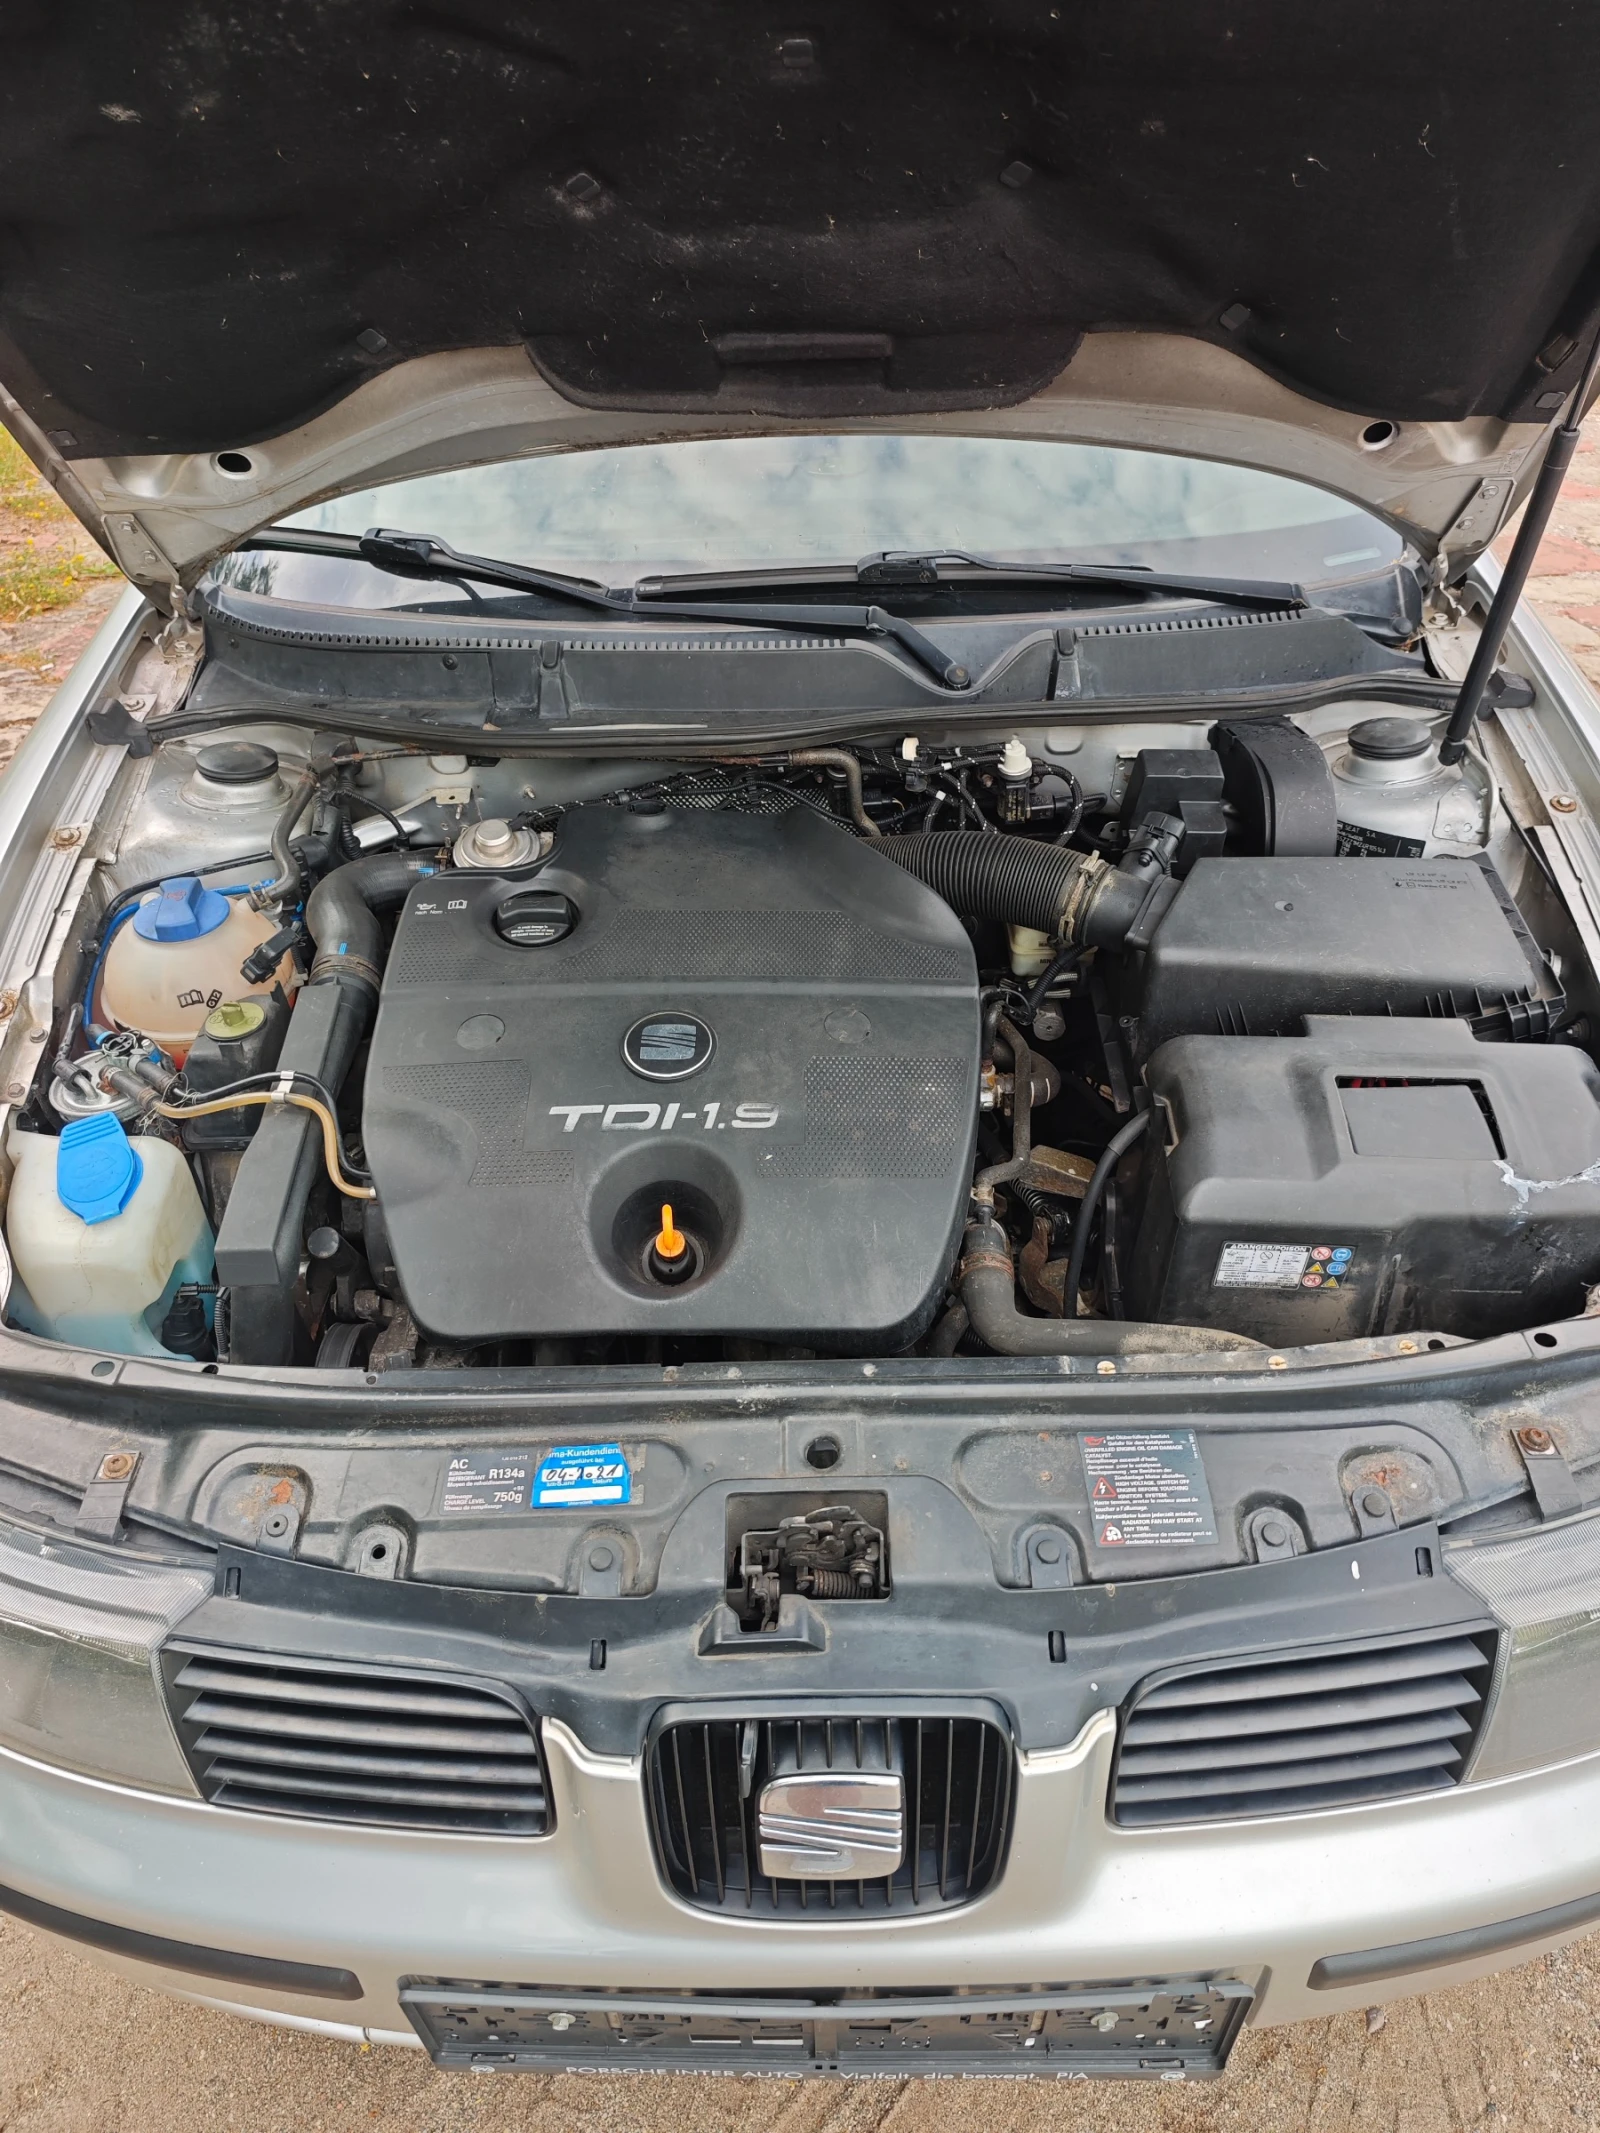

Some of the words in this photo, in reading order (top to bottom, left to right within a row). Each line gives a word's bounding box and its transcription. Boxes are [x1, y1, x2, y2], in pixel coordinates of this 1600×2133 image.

[1344, 824, 1360, 833] SEAT
[449, 1458, 469, 1469] AC
[488, 1468, 525, 1479] R134a
[493, 1491, 522, 1503] 750g
[566, 2066, 666, 2076] PORSCHE
[675, 2069, 735, 2077] INTER
[742, 2070, 804, 2079] AUTO
[840, 2072, 916, 2081] Vielfalt,
[922, 2072, 954, 2080] die
[962, 2072, 1040, 2081] bewegt.
[1056, 2072, 1089, 2080] PIA
